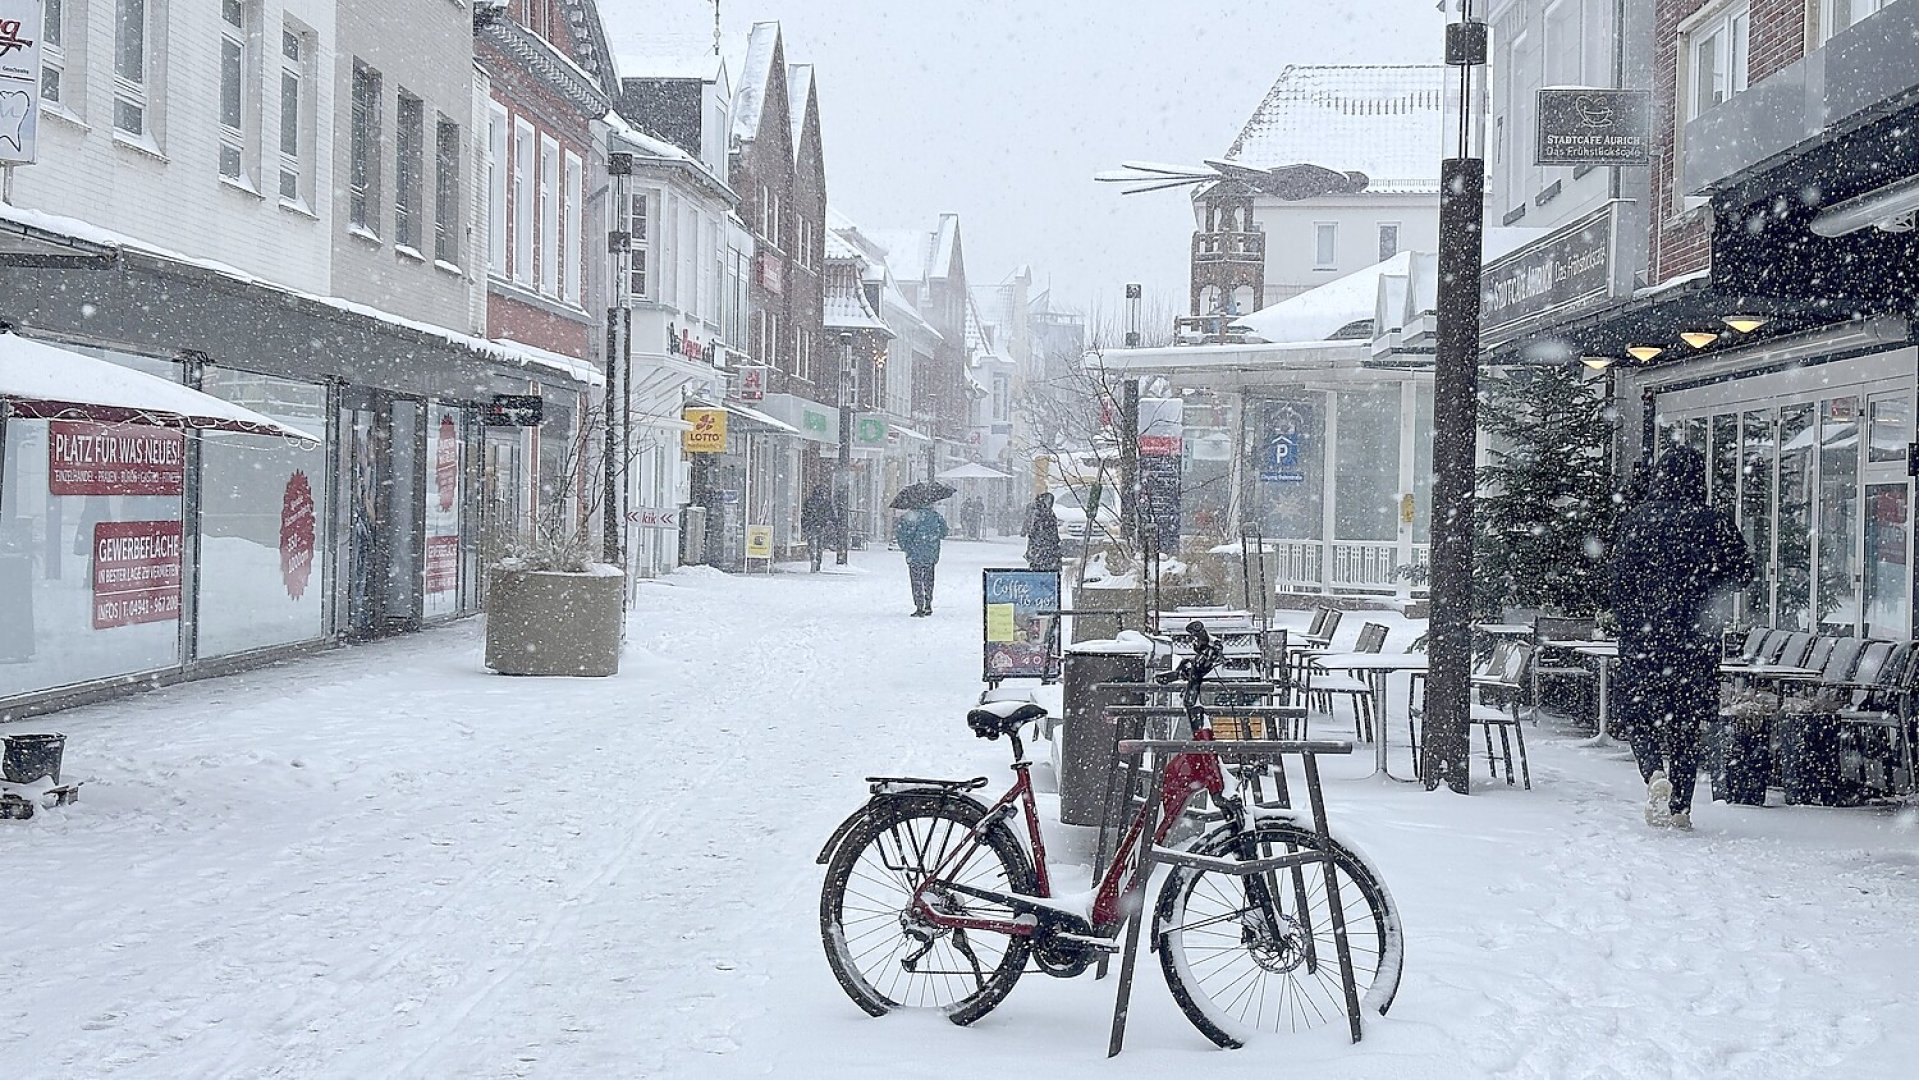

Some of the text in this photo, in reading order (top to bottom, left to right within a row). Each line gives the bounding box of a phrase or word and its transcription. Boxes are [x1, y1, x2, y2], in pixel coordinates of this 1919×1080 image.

[1603, 135, 1640, 145] AURICH
[1546, 146, 1565, 156] Das
[1555, 260, 1568, 282] Das
[690, 433, 720, 442] LOTTO
[55, 429, 180, 465] PLATZ FÜR WAS NEUES!
[1276, 443, 1288, 464] P
[642, 511, 657, 524] kik
[99, 530, 179, 562] GEWERBEFLÄCHE
[127, 566, 141, 581] LAGE
[993, 577, 1029, 600] Coffee
[1020, 594, 1031, 606] to
[97, 601, 119, 620] INFOS
